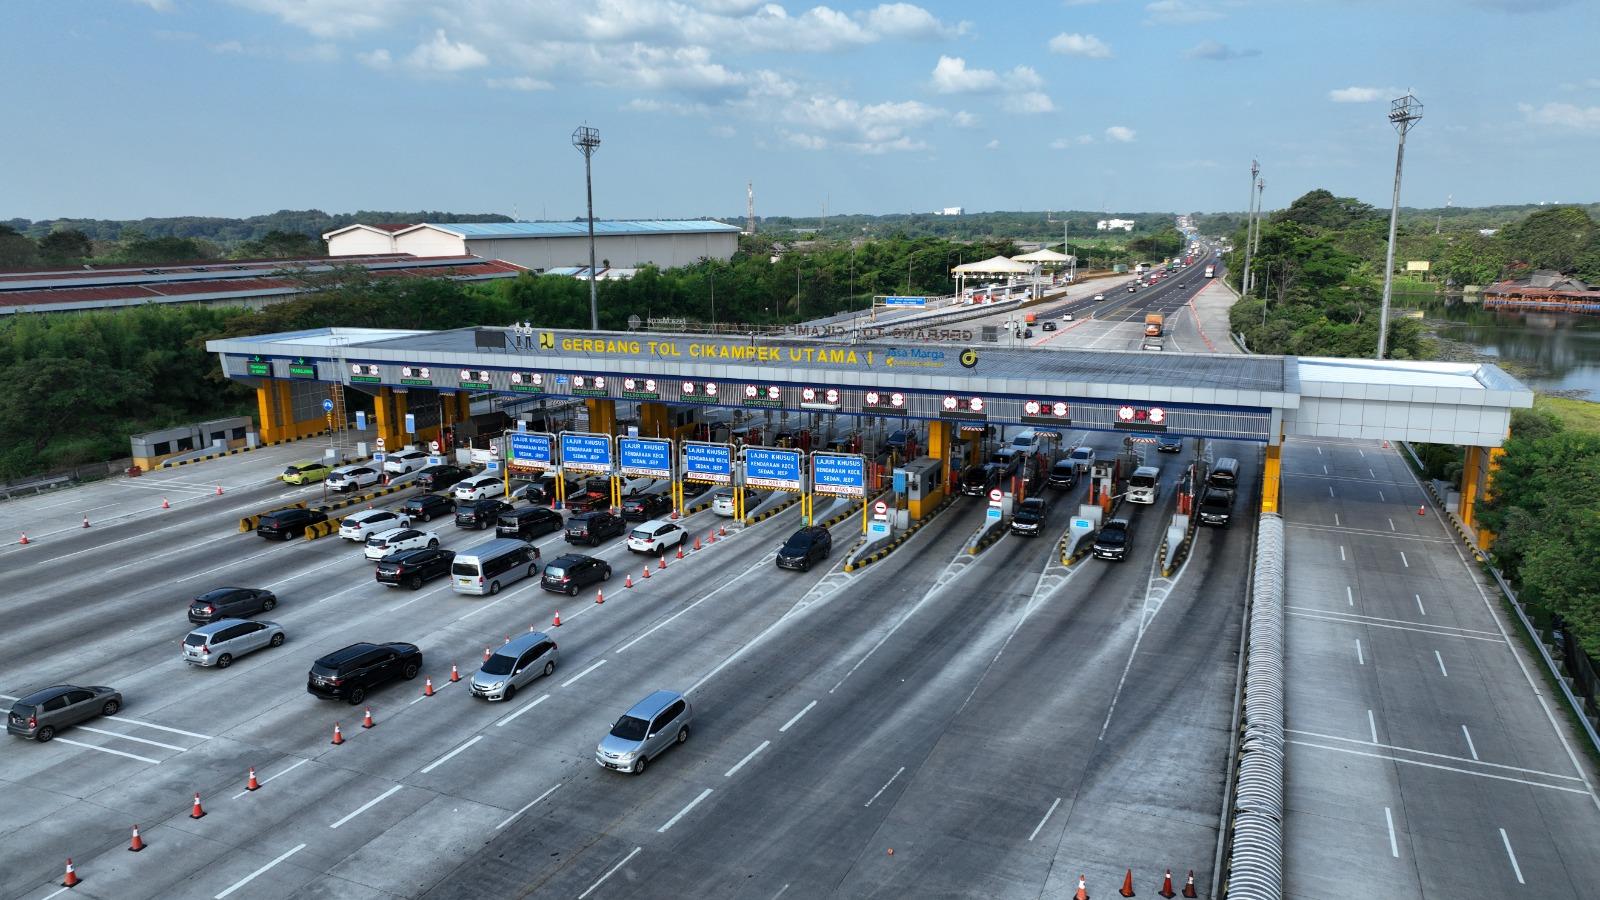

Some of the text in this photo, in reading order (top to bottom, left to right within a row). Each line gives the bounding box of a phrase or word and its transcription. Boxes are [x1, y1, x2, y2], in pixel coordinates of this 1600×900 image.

[562, 338, 640, 354] GERBANG
[648, 342, 681, 356] TOL
[688, 343, 780, 361] CIKAMPEK
[789, 348, 857, 363] UTAMA
[911, 349, 945, 360] Marga
